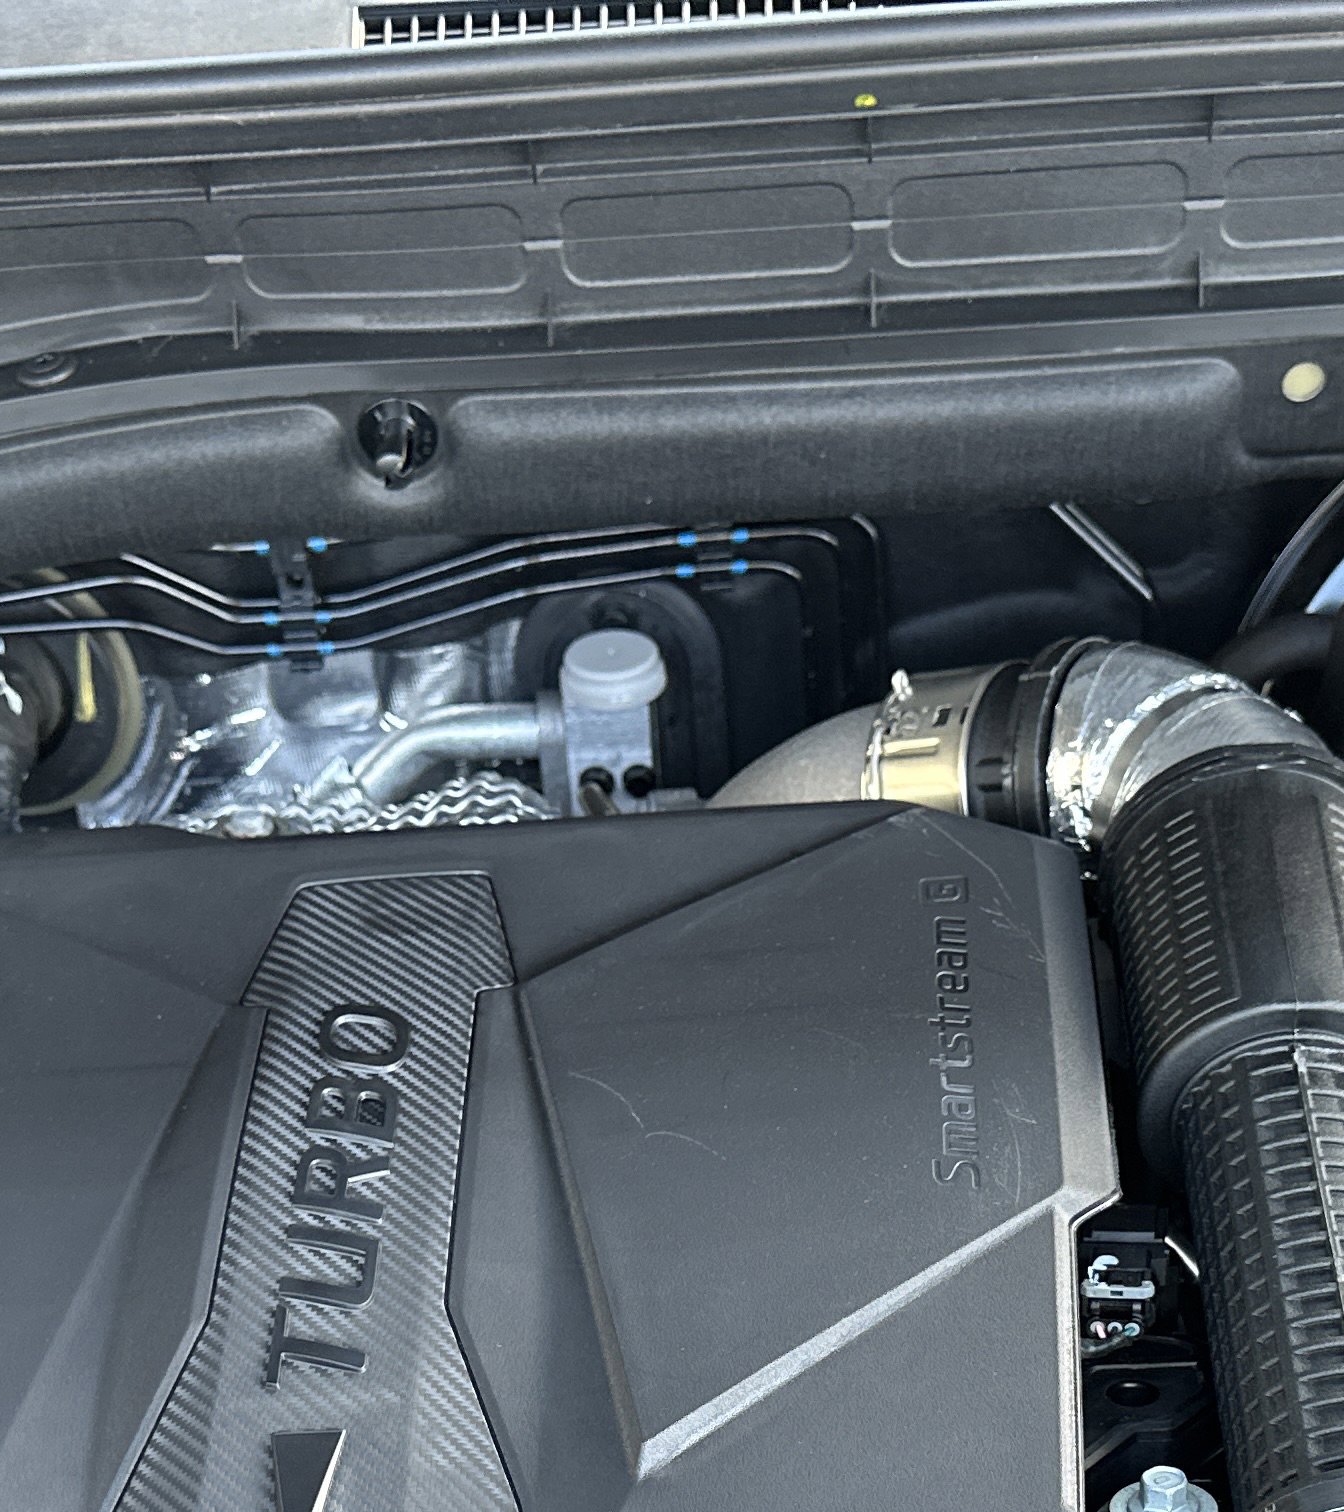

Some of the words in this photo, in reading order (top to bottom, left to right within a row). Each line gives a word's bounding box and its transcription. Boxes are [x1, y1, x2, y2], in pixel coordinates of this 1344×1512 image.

[922, 876, 968, 903] G
[927, 915, 981, 1189] Smartstream
[264, 1003, 412, 1391] TURBO
